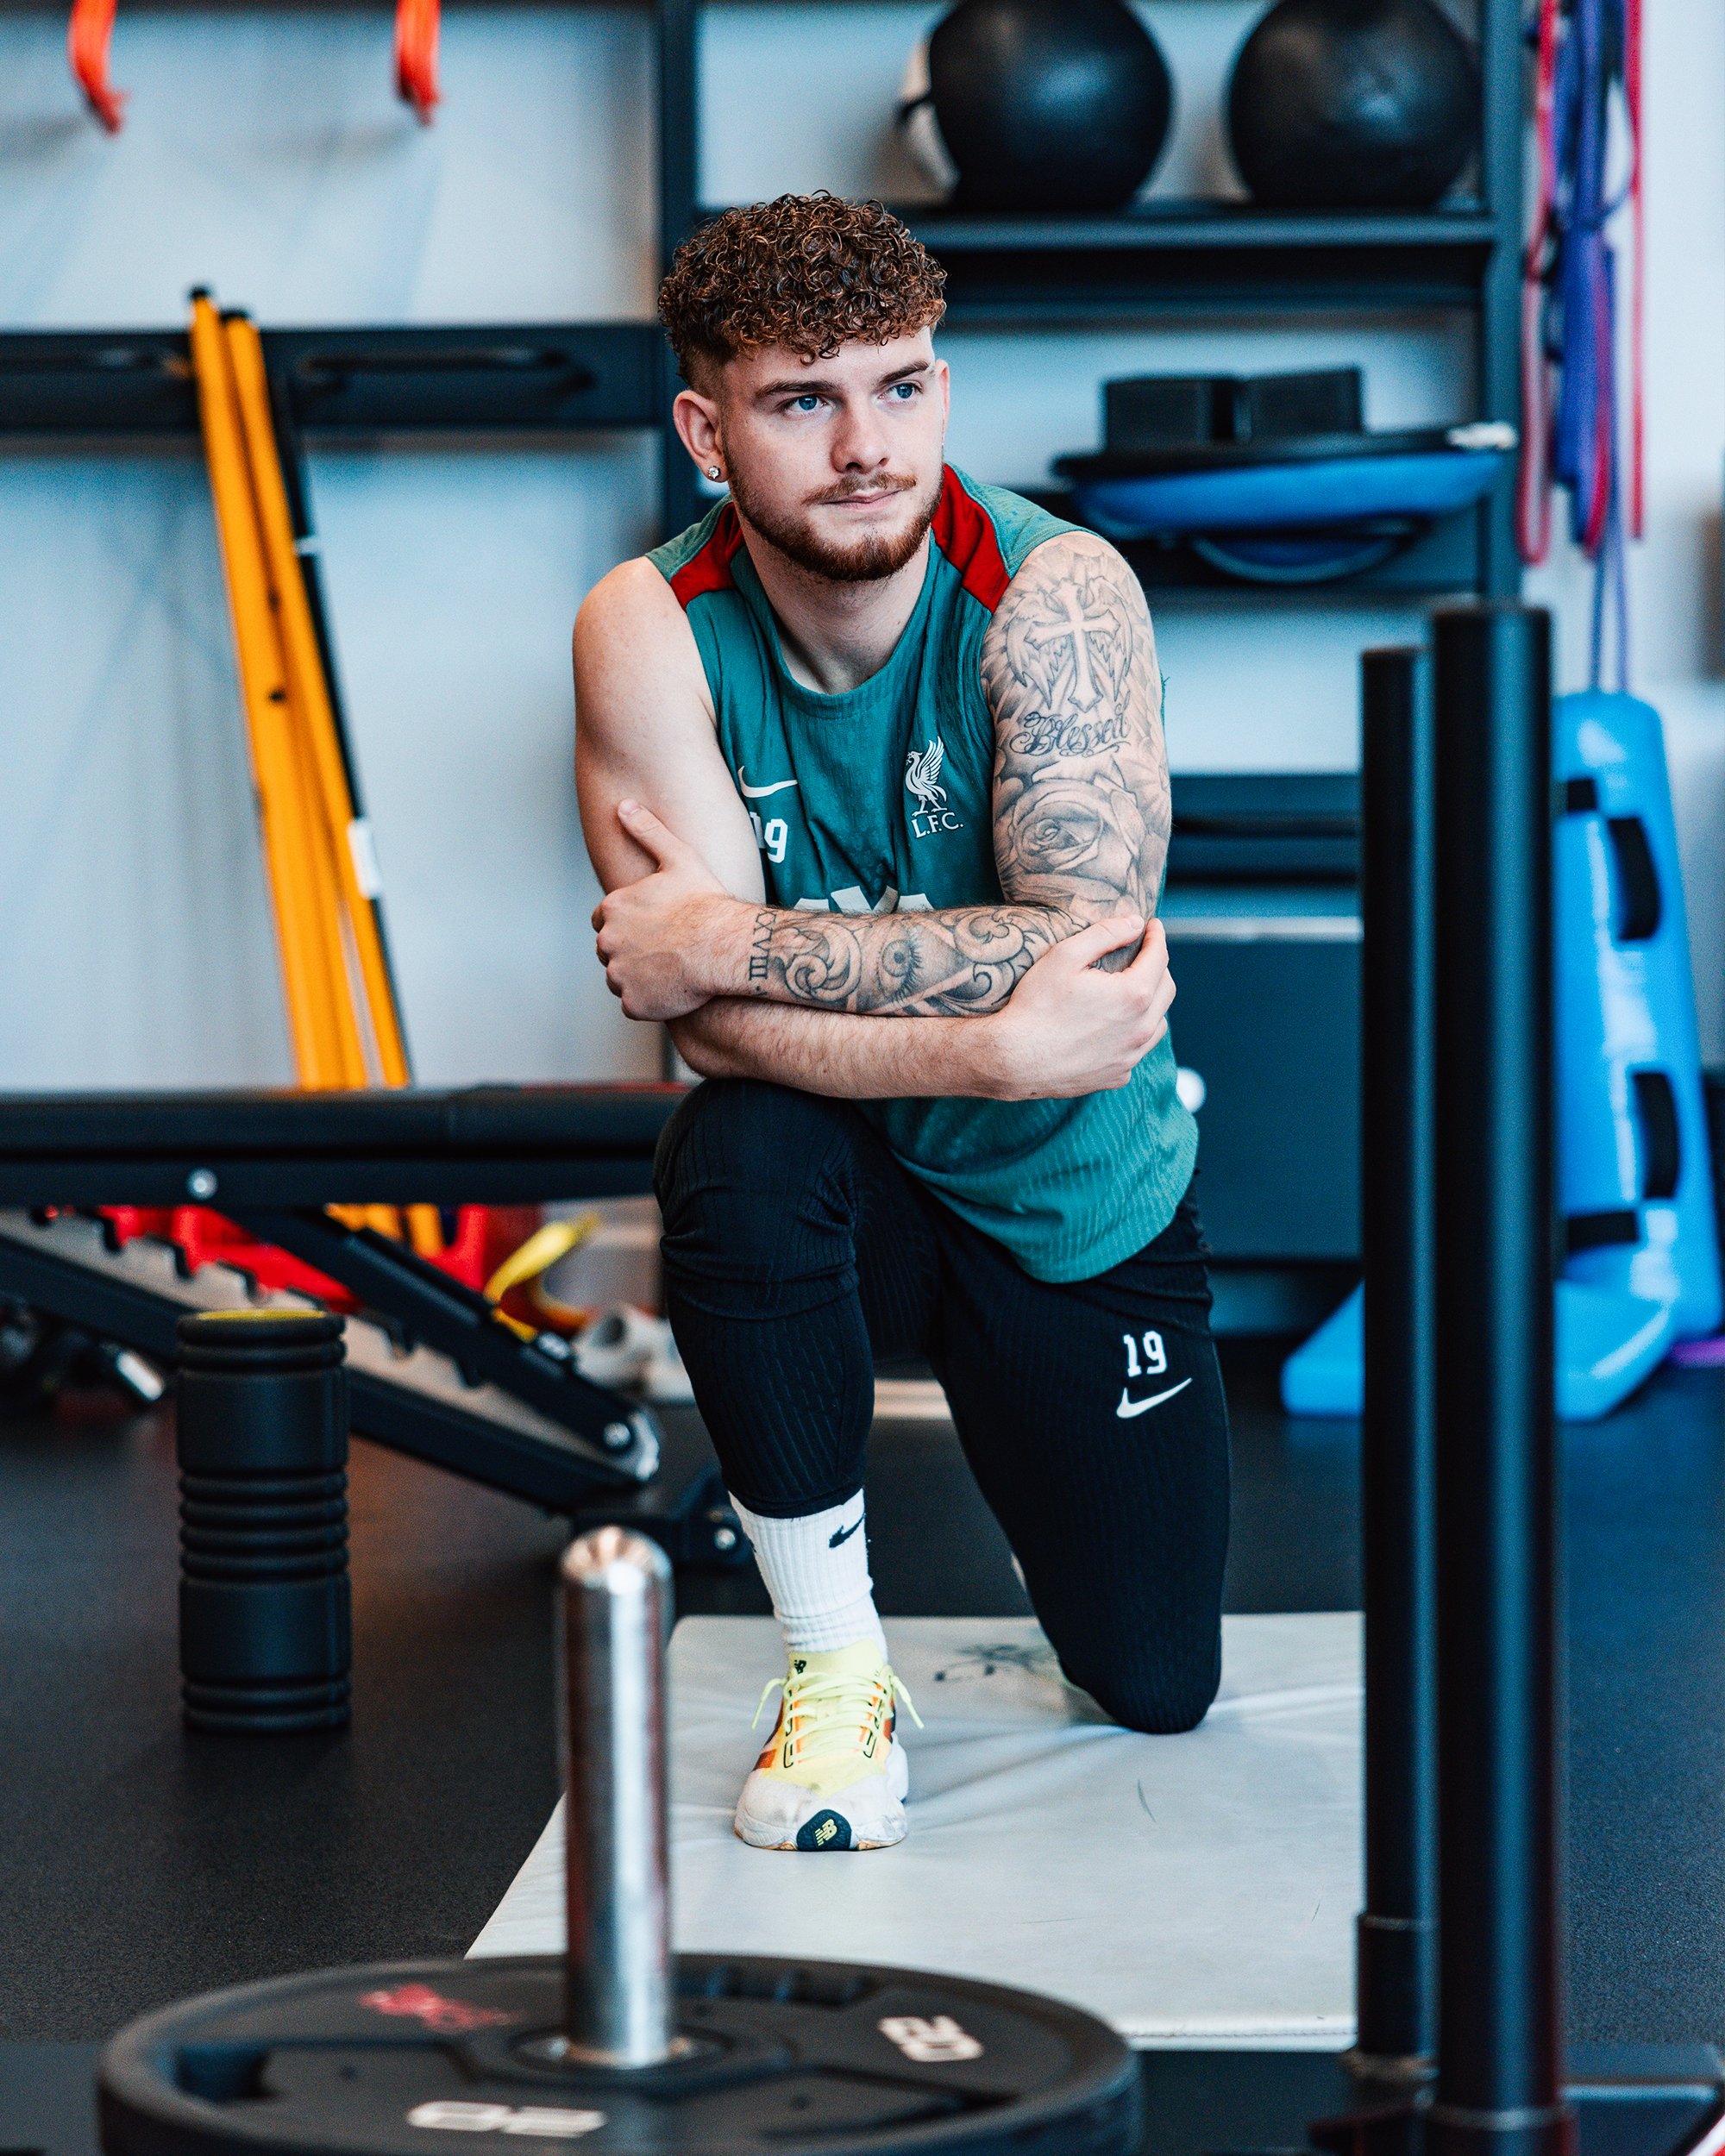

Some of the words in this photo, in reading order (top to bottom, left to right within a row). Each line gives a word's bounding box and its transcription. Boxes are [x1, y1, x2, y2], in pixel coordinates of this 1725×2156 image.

[1009, 690, 1132, 758] Blessed
[911, 812, 964, 838] L.F.C.
[1123, 1331, 1168, 1377] 19
